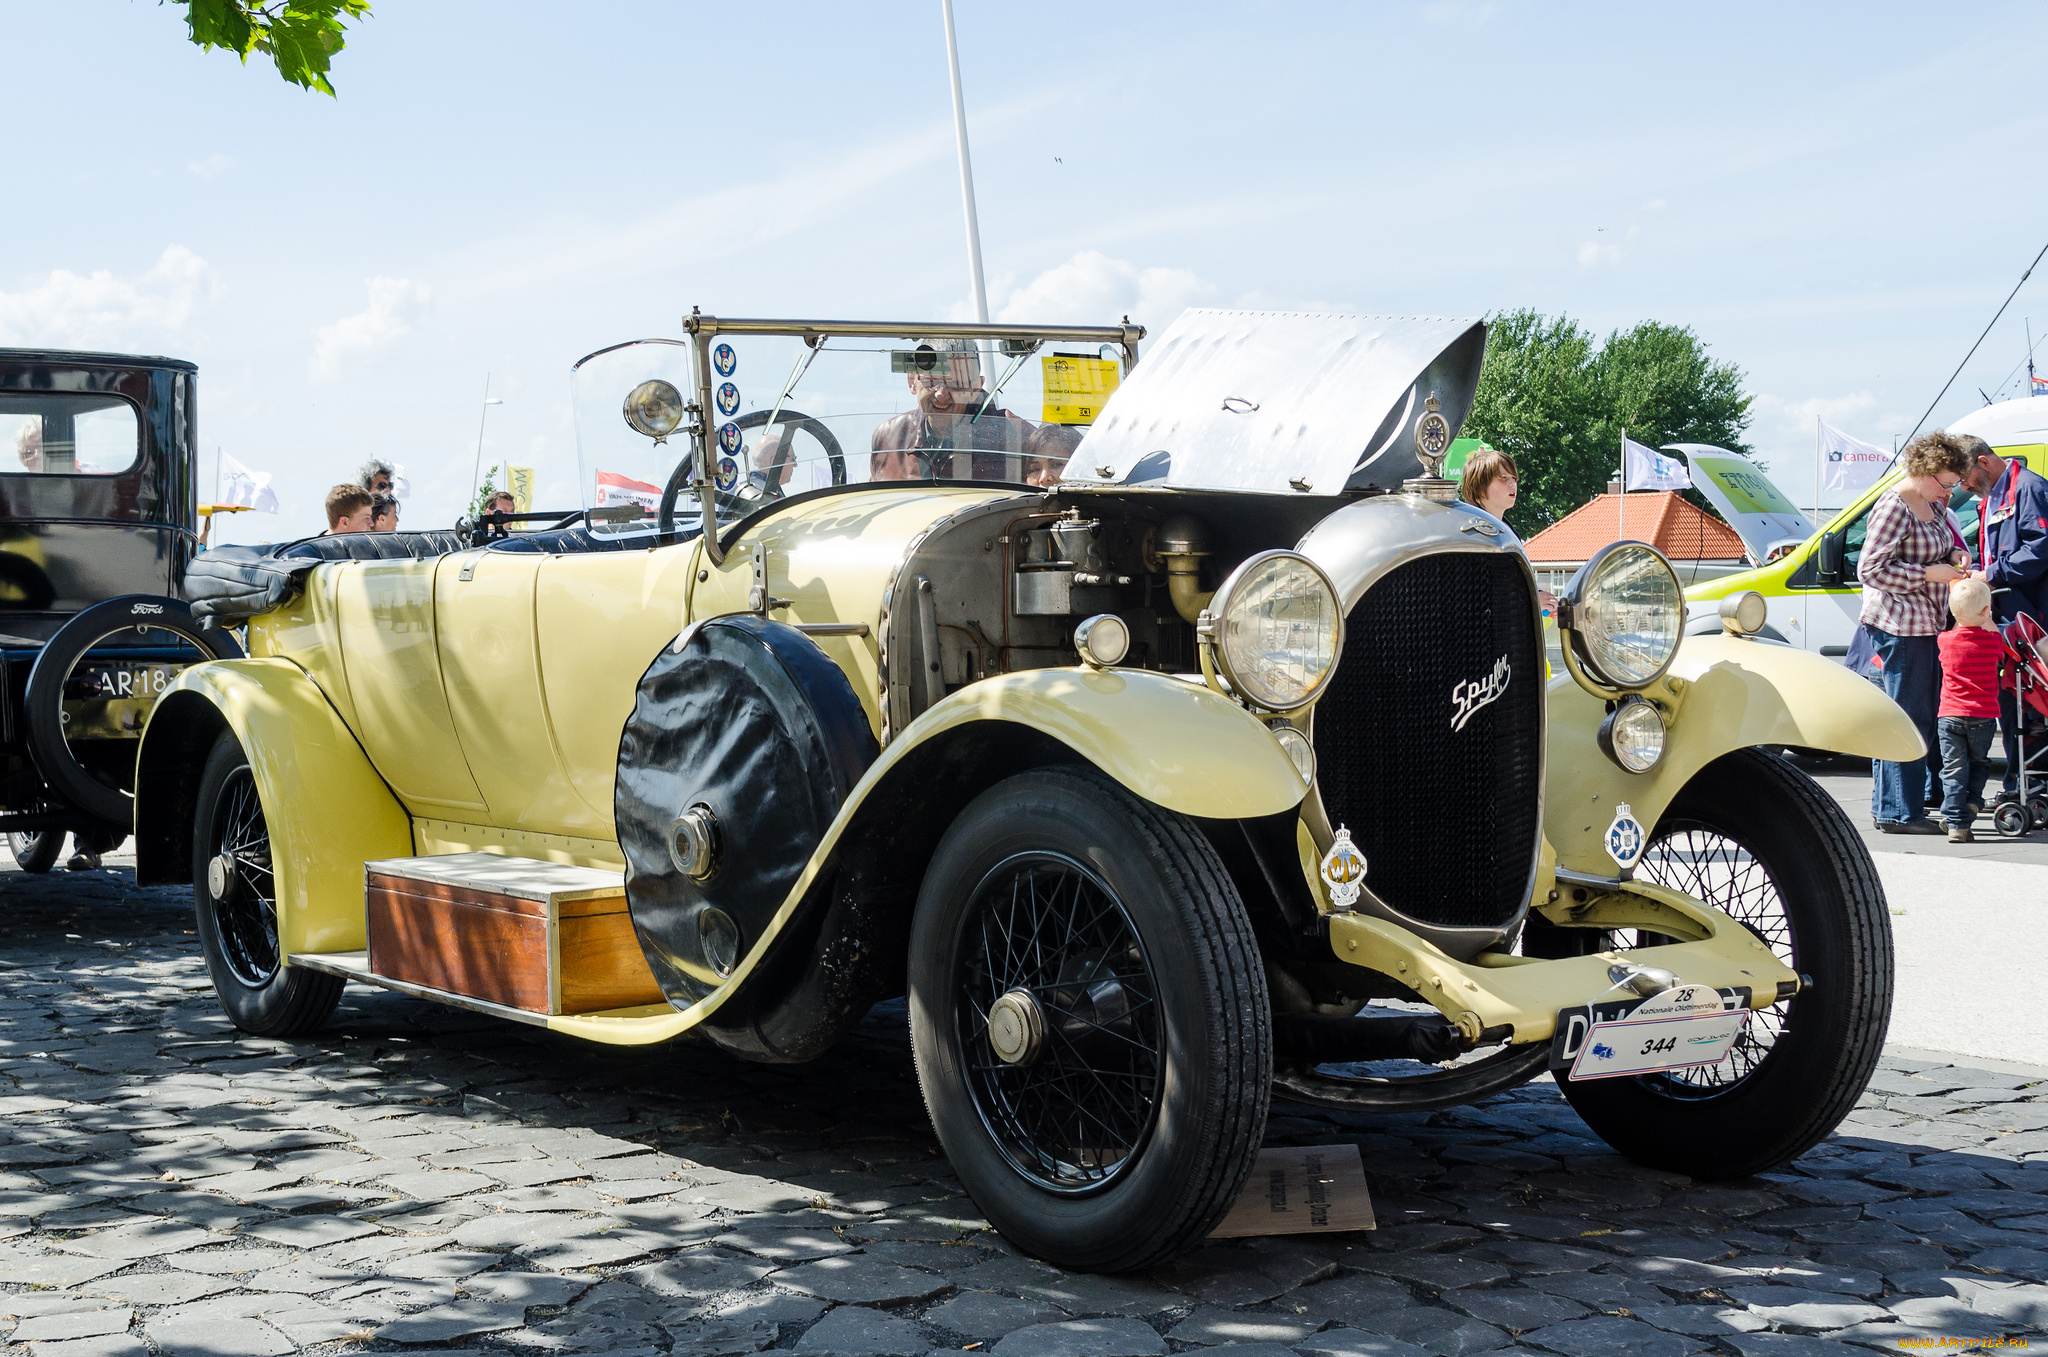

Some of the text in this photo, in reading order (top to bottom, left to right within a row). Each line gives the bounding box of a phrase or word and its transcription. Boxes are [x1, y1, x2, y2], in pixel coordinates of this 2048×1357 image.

[1449, 468, 1463, 476] VA
[131, 603, 164, 614] Ford
[1638, 1005, 1674, 1015] Nationale
[1674, 1002, 1719, 1012] Oldtimerdag
[1640, 1036, 1677, 1056] 344
